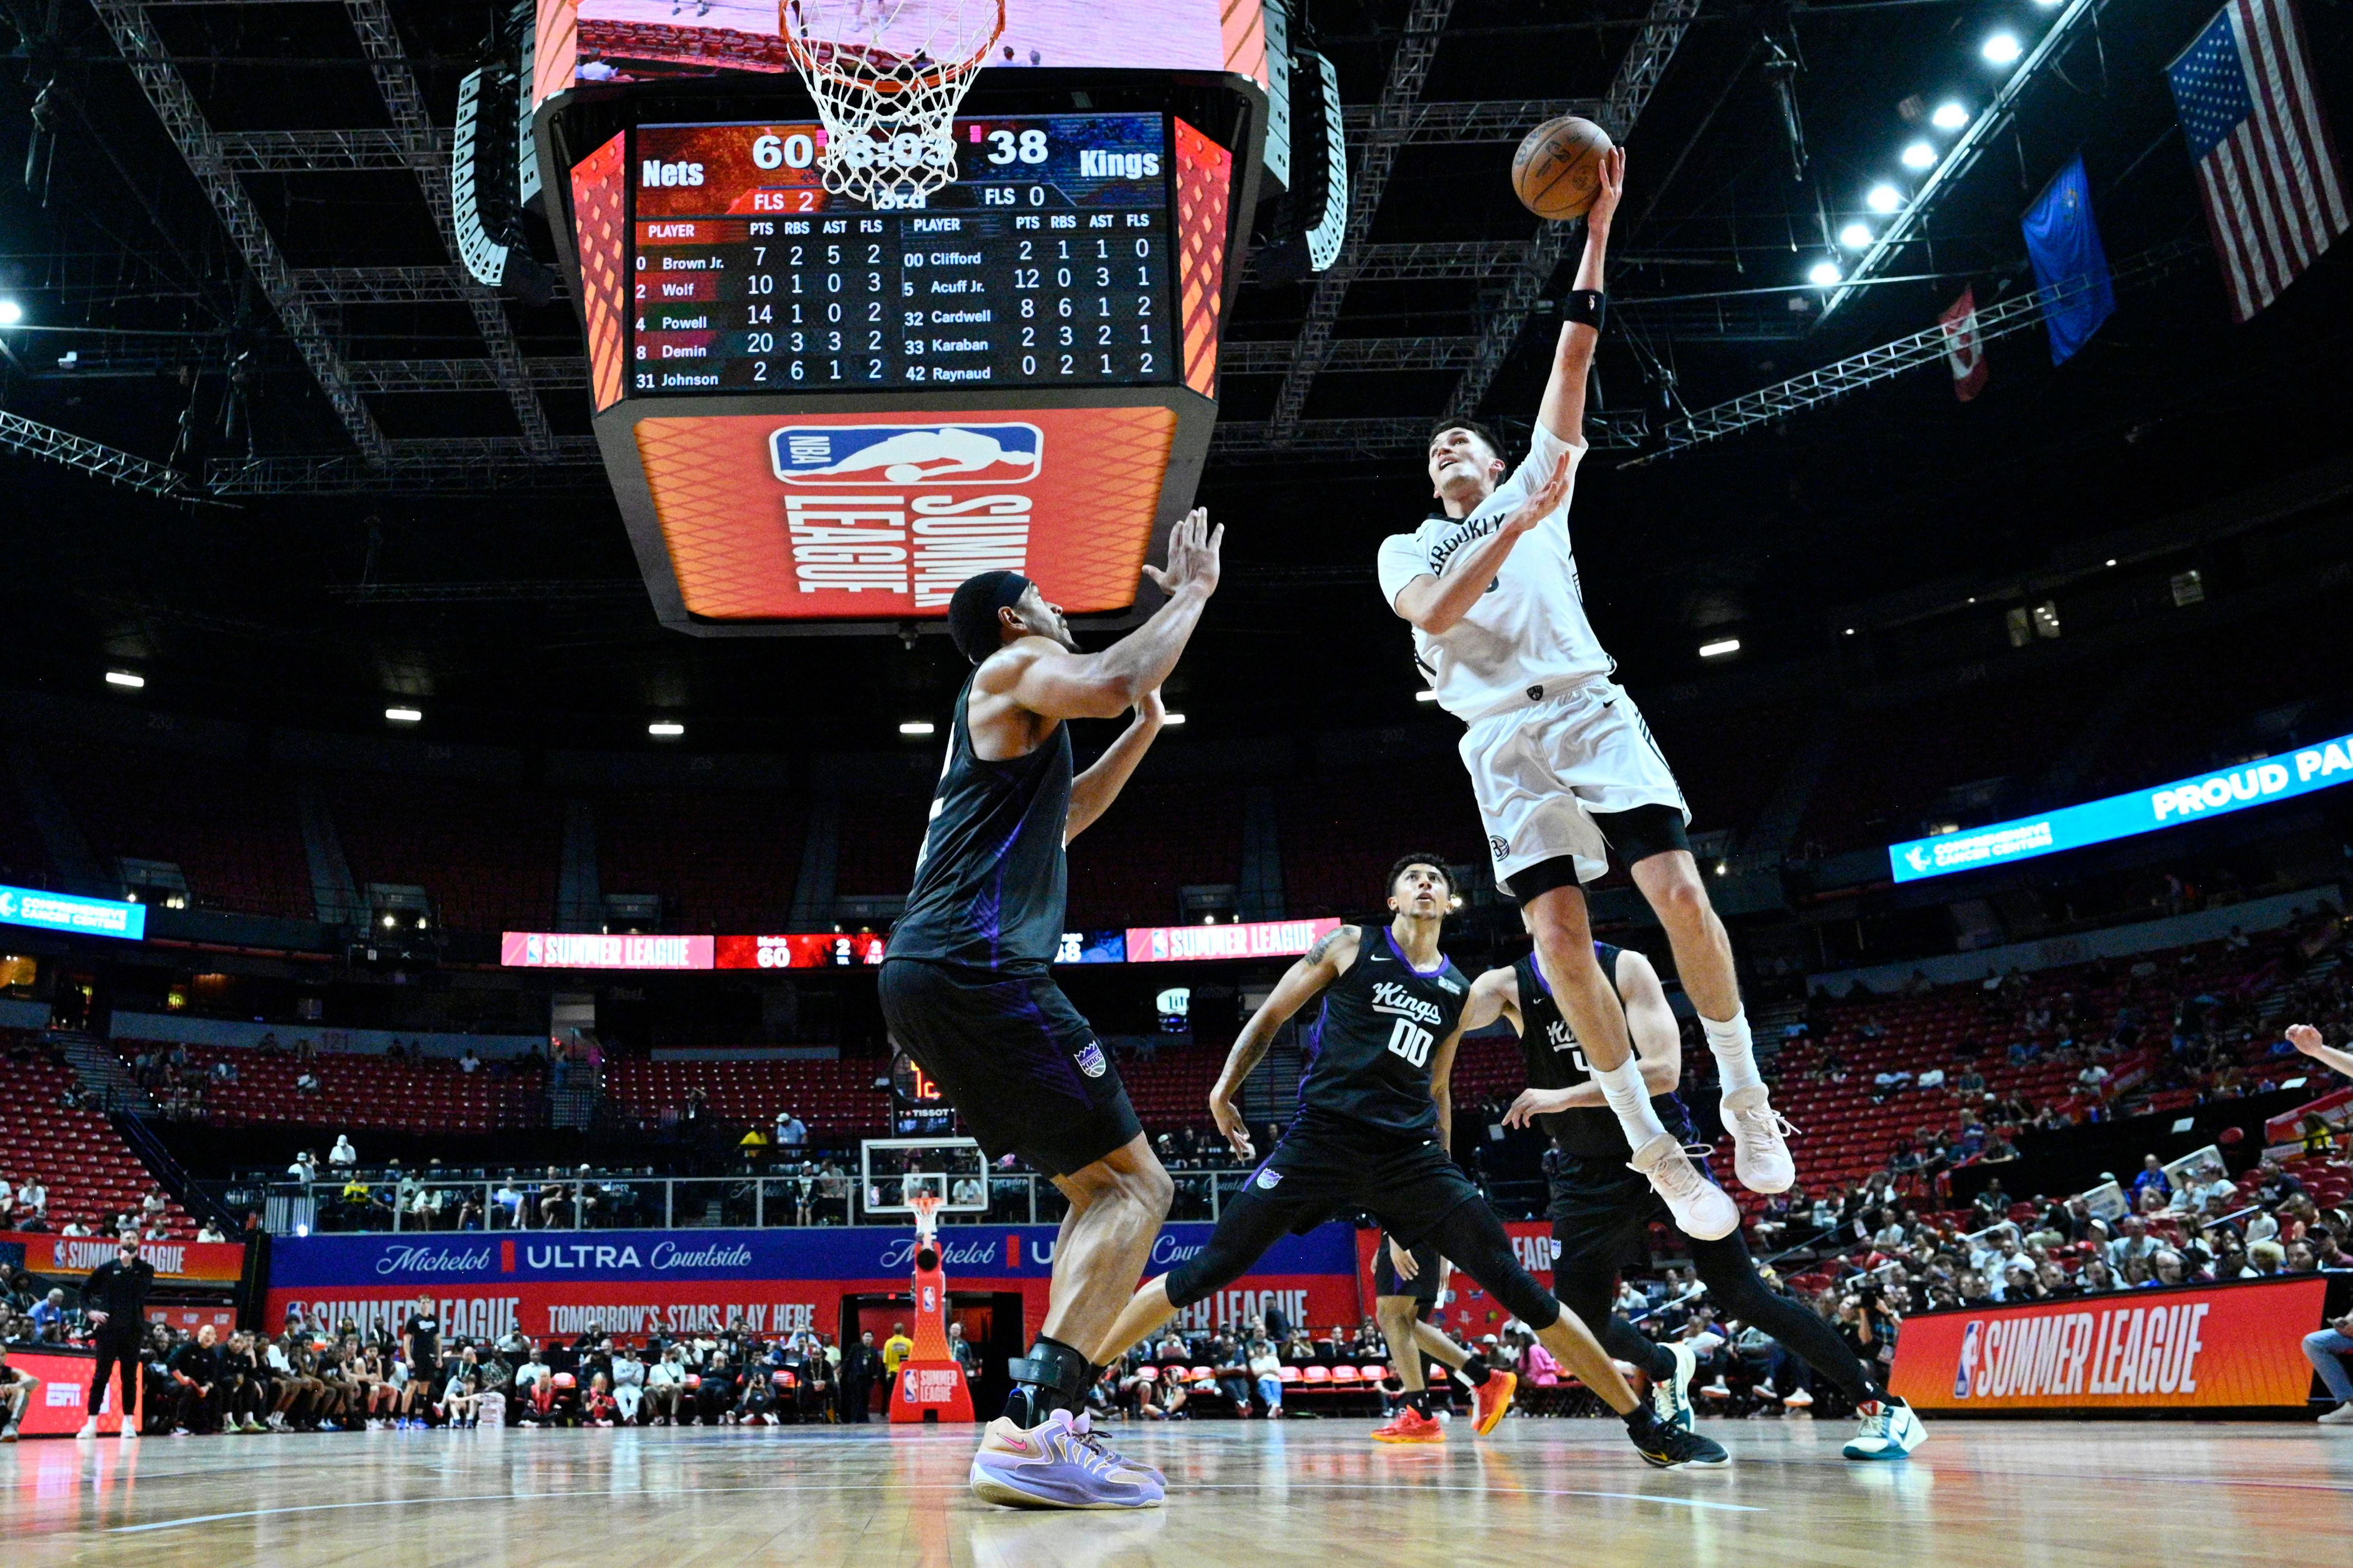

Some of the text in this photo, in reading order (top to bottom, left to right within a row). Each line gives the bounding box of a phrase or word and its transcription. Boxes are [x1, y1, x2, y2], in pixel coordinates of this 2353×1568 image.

[752, 134, 814, 169] 60
[987, 129, 1049, 164] 38
[642, 159, 704, 187] Nets
[1080, 149, 1159, 181] Kings
[754, 191, 814, 212] FLS 2
[985, 186, 1044, 206] FLS 0
[648, 219, 883, 238] PLAYER PTS RBS AST FLS
[913, 214, 1149, 232] PLAYER PTS RBS AST FLS
[636, 244, 880, 271] 0 Brown Jr. 7 2 5 2
[904, 238, 1149, 267] 00 Clifford 2 1 1 0
[635, 272, 881, 299] 2 Wolf 10 1 0 3
[904, 266, 1149, 297] 5 Acuff Jr. 12 0 3 1
[635, 302, 881, 332] 4 Powell 14 1 0 2
[904, 296, 1151, 327] 32 Cardwell 8 6 1 2
[636, 330, 881, 360] 8 Demin 20 3 3 2
[904, 324, 1152, 355] 33 Karaban 2 3 2 1
[636, 358, 881, 389] 31 Johnson 2 6 1 2
[906, 352, 1153, 382] 42 Raynaud 0 2 1 2
[789, 436, 832, 464] NBA
[784, 495, 908, 594] LEAGUE
[911, 494, 1033, 608] SUMM
[1430, 513, 1506, 579] BROOKLY
[2152, 738, 2353, 821] PROUD PA
[545, 936, 690, 966] SUMMER LEAGUE
[836, 938, 851, 955] 2
[1170, 923, 1316, 957] SUMMER LEAGUE
[757, 947, 790, 967] 60
[1372, 981, 1441, 1025] Kings
[1388, 1017, 1434, 1068] 00
[1081, 1052, 1103, 1070] KINGS
[912, 1108, 950, 1117] TISSOT
[68, 1241, 186, 1274] SUMME EAGUE
[376, 1241, 752, 1274] Michelob ULTRA Courtside
[880, 1238, 997, 1268] Mhelob
[548, 1305, 661, 1334] TOMORROW'S
[667, 1305, 720, 1333] STARS
[773, 1304, 815, 1331] HERE
[1976, 1302, 2209, 1398] SUMMER LEAGUE
[919, 1369, 958, 1386] SUMMER
[919, 1386, 952, 1402] LEAGUE
